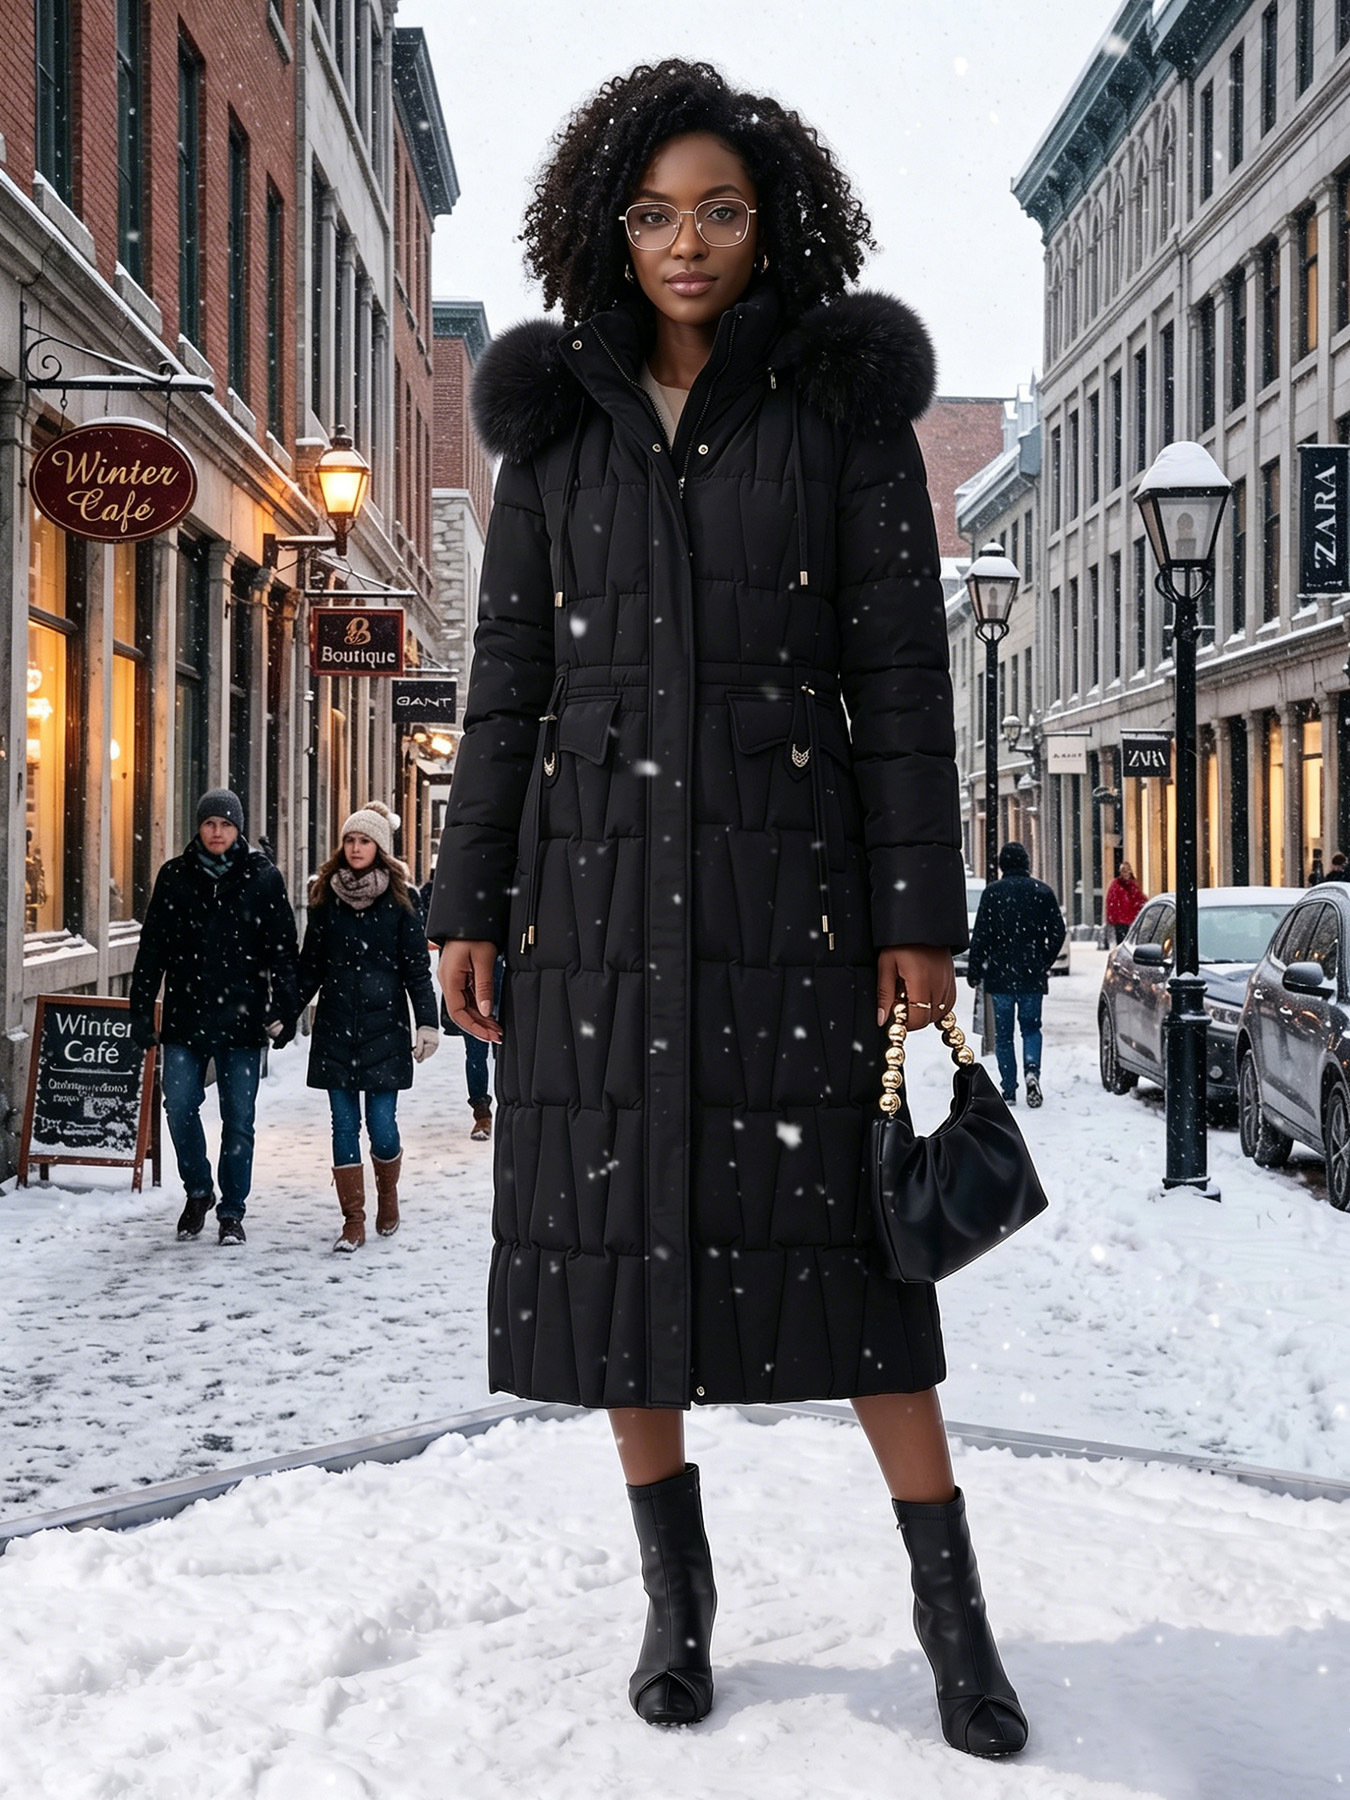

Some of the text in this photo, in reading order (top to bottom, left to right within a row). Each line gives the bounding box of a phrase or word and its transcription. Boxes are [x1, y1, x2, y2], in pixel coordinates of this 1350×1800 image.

[51, 449, 180, 485] Winter
[67, 488, 155, 533] Café
[1314, 465, 1336, 568] ZARA
[321, 646, 396, 669] Boutique
[396, 696, 452, 708] GANT
[64, 1040, 120, 1064] Café
